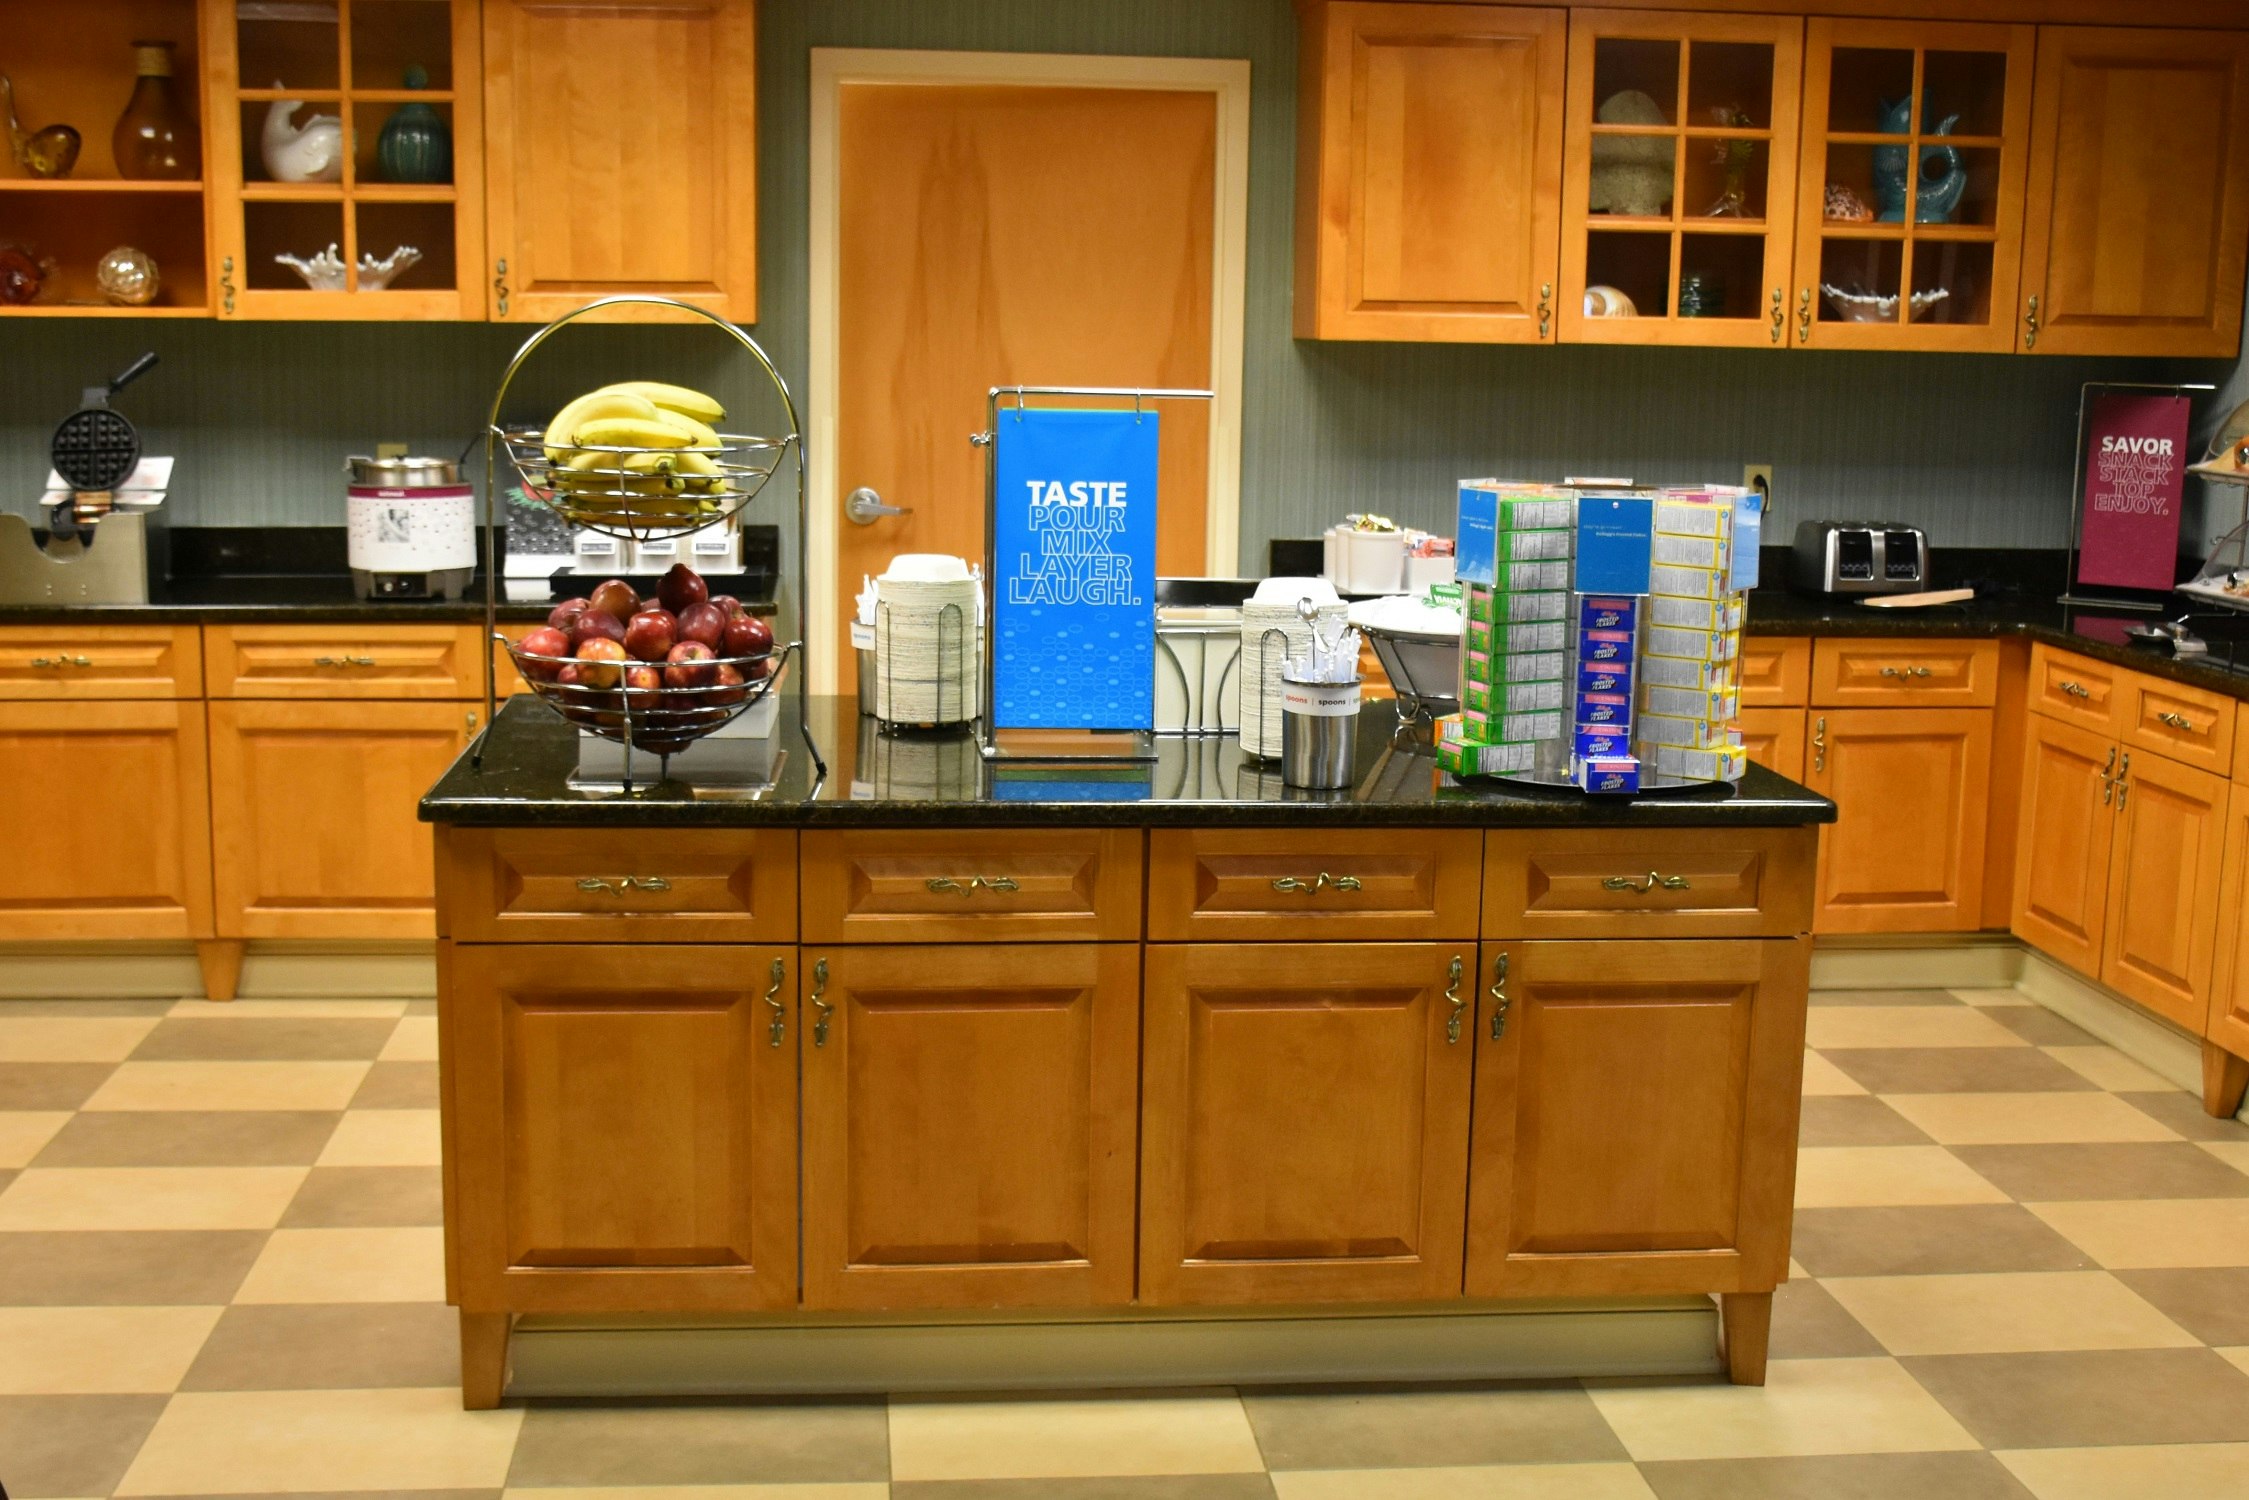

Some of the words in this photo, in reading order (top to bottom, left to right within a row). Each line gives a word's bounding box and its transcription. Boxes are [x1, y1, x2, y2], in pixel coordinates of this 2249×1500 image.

[2101, 436, 2173, 455] SAVOR
[2098, 450, 2174, 471] SNACK
[2099, 466, 2169, 486] STACK
[1026, 481, 1127, 507] TASTE
[2112, 480, 2155, 498] TOP
[2094, 493, 2169, 516] ENJOY.
[1028, 504, 1126, 532] POUR
[1041, 529, 1113, 556] MIX
[1020, 552, 1133, 580] LAYER
[1009, 577, 1142, 606] LAUGH.
[1318, 698, 1346, 706] spoons
